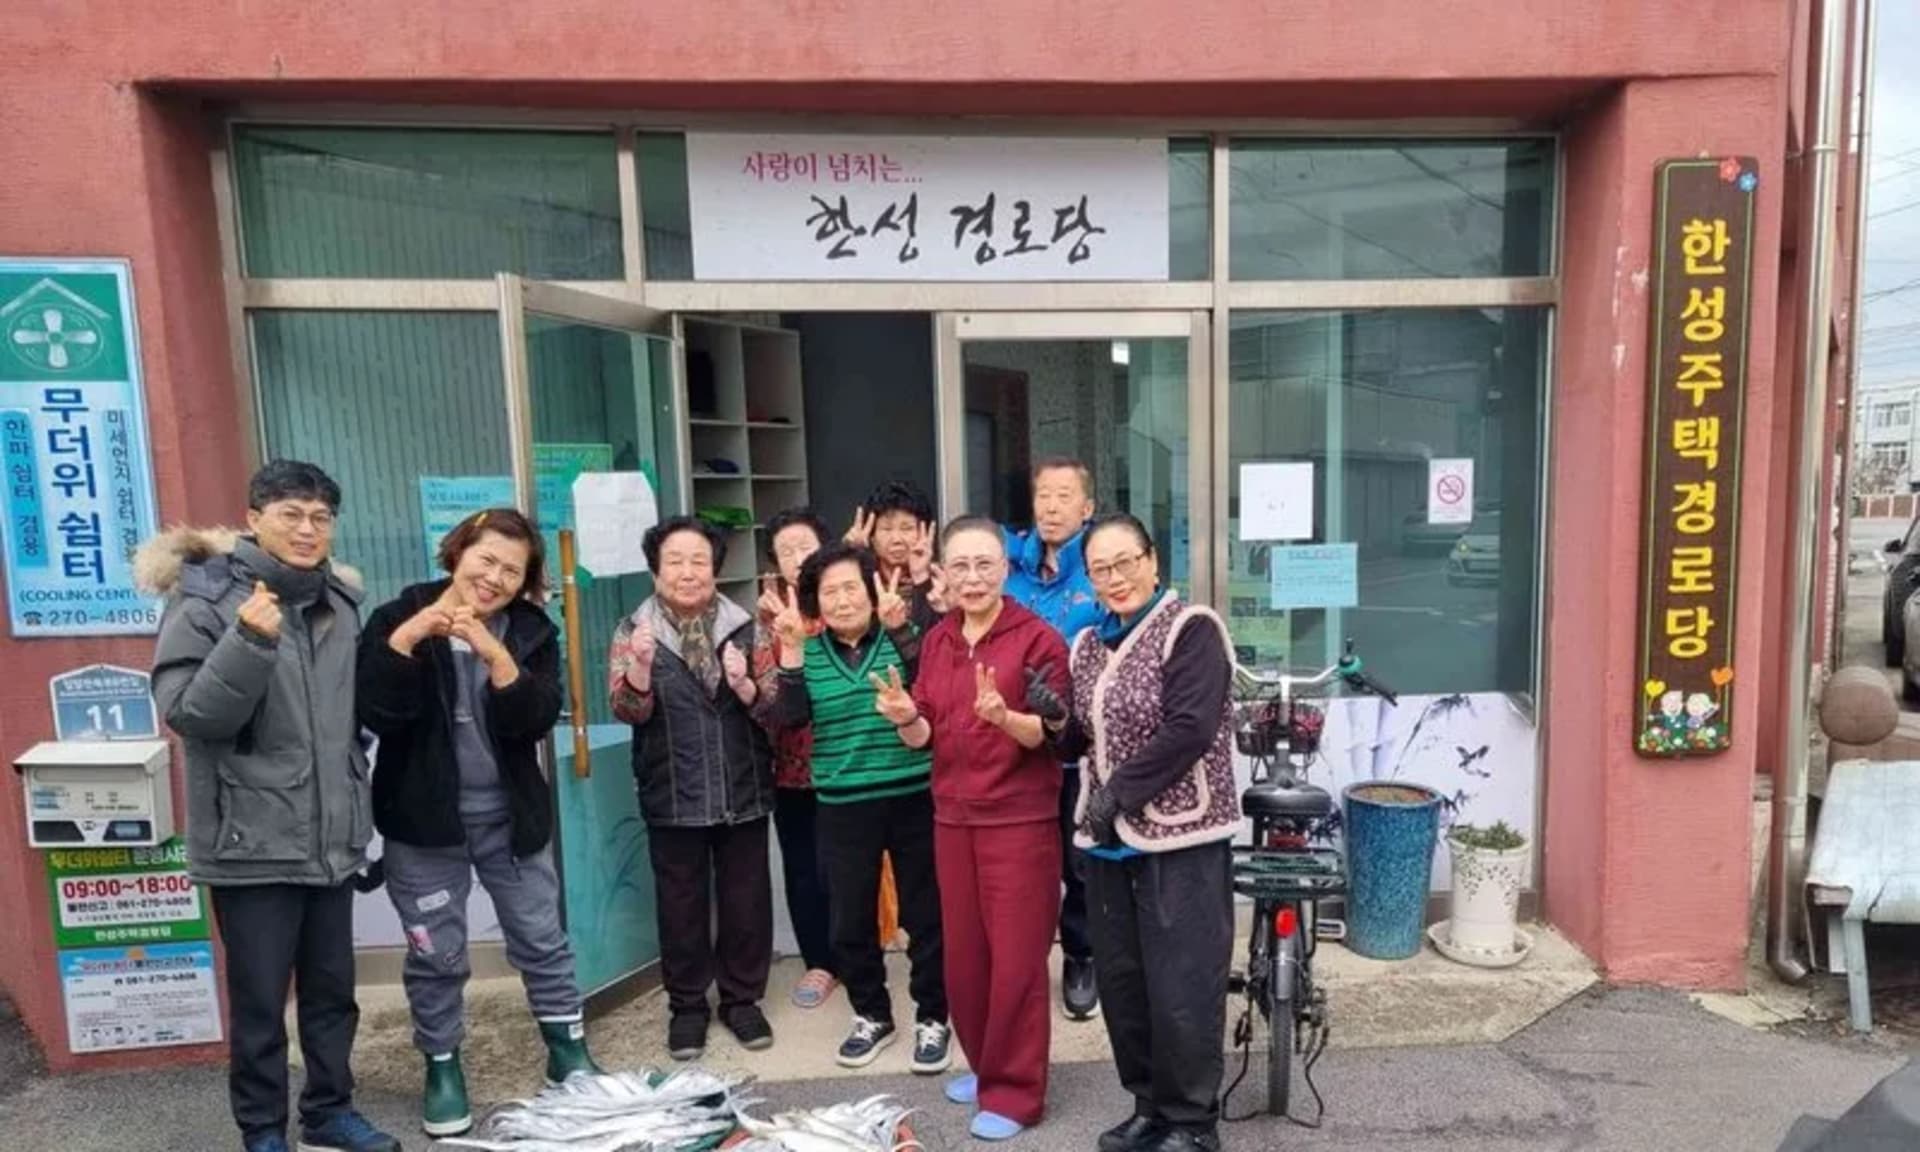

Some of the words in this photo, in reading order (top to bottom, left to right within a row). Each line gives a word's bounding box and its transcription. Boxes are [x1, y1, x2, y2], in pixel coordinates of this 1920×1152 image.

[742, 151, 818, 183] 사랑이
[806, 191, 920, 265] 한성
[949, 191, 1106, 265] 경로당
[41, 388, 97, 499] 무더위
[1665, 218, 1732, 659] 한성주택경로당
[57, 511, 105, 584] 쉼터
[19, 589, 93, 603] (COOLING
[49, 608, 158, 626] 270-4806
[86, 704, 124, 731] 11
[63, 875, 192, 899] 09:00~18:00
